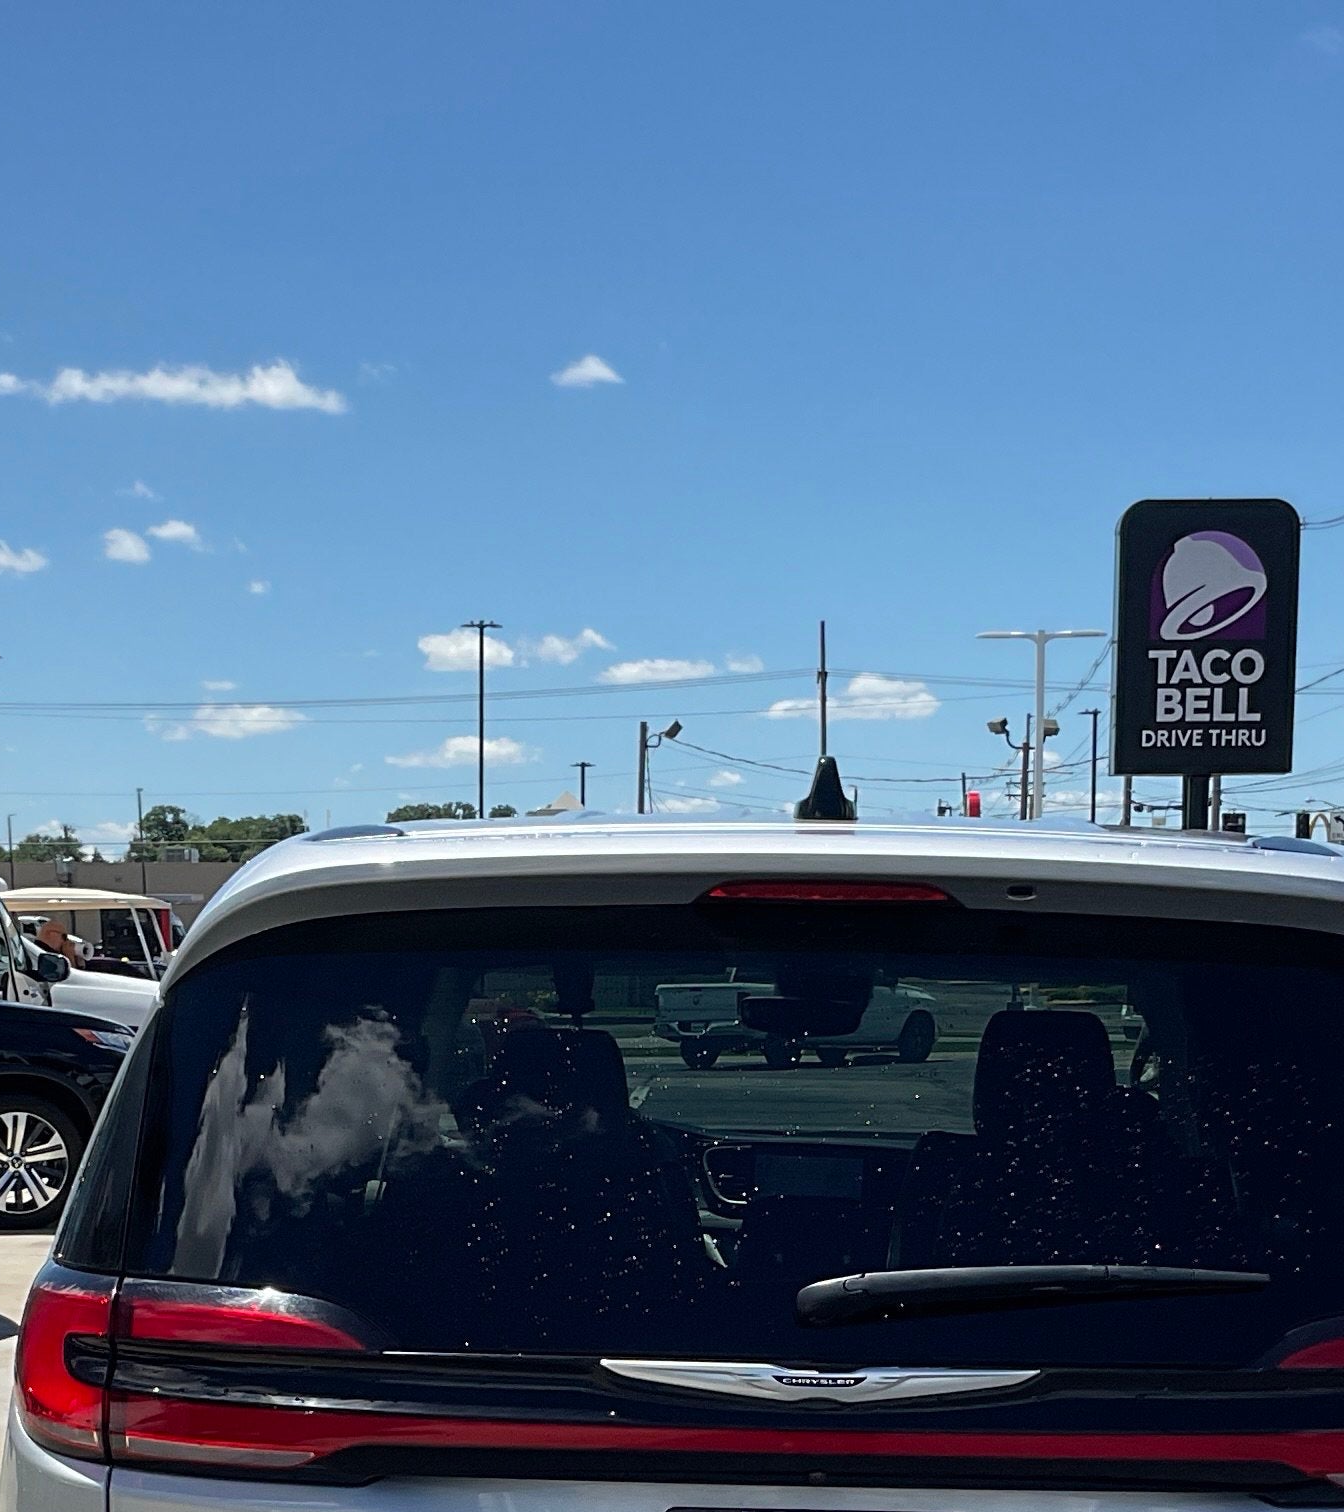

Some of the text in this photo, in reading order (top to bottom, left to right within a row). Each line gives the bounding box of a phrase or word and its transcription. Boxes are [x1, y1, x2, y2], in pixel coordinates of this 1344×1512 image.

[1148, 648, 1265, 685] TACO
[1156, 687, 1262, 723] BELL
[1141, 728, 1266, 747] DRIVE THRU
[782, 1377, 855, 1385] CHRYSLER
